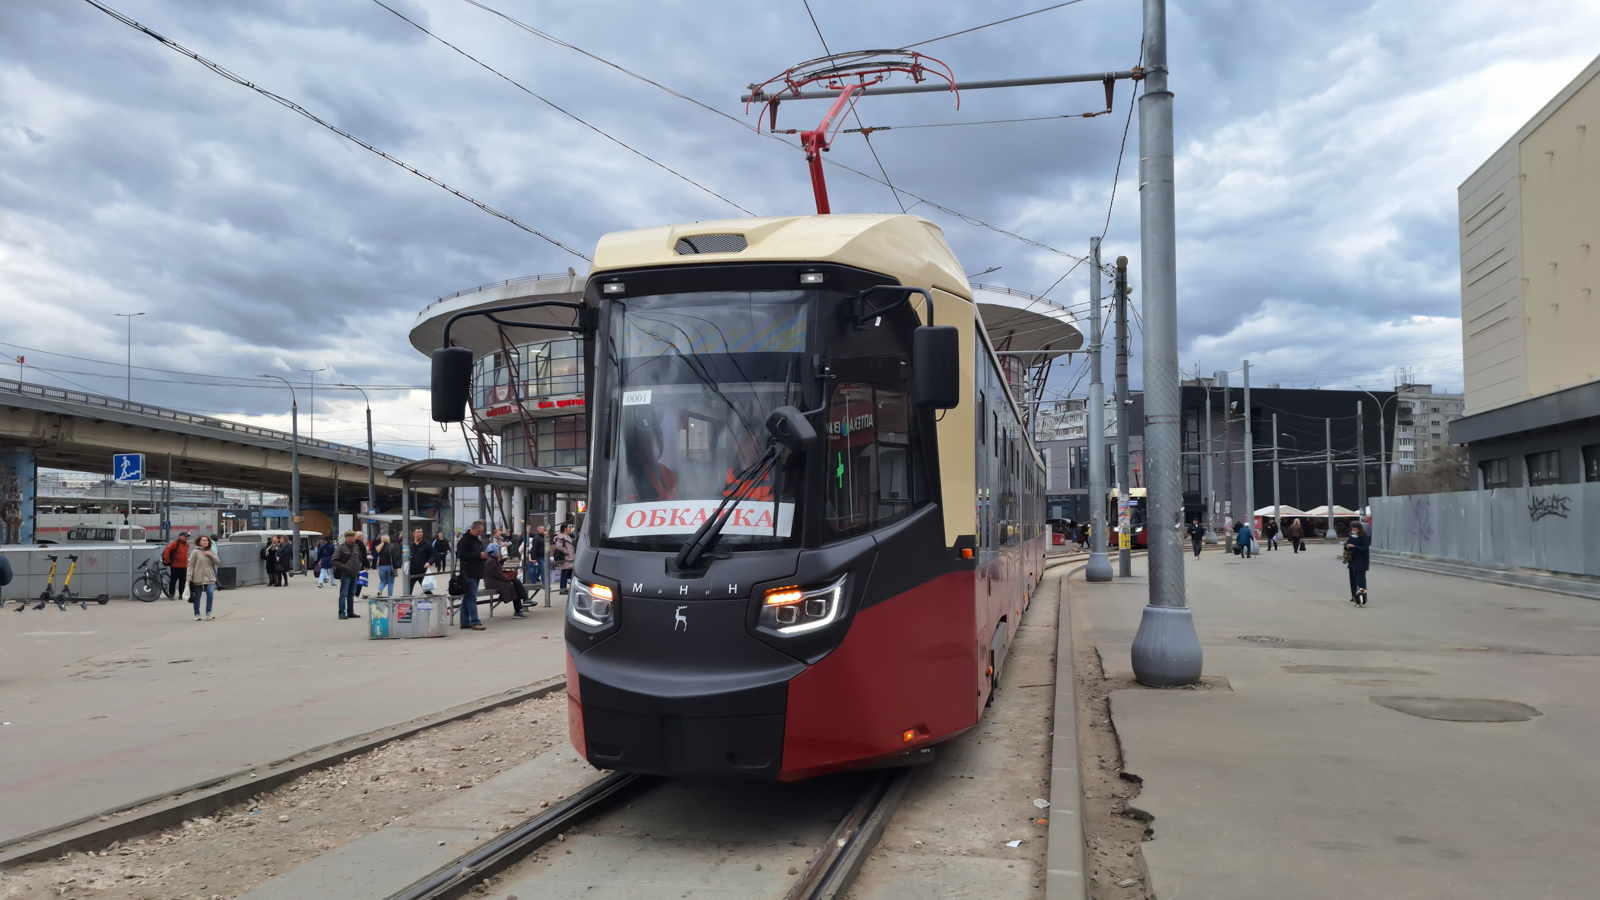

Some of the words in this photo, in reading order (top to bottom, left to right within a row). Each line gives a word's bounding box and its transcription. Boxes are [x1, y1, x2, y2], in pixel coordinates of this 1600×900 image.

[537, 401, 555, 409] БАЗА
[556, 398, 585, 408] ЦВЕТОВ
[626, 393, 647, 404] 0001
